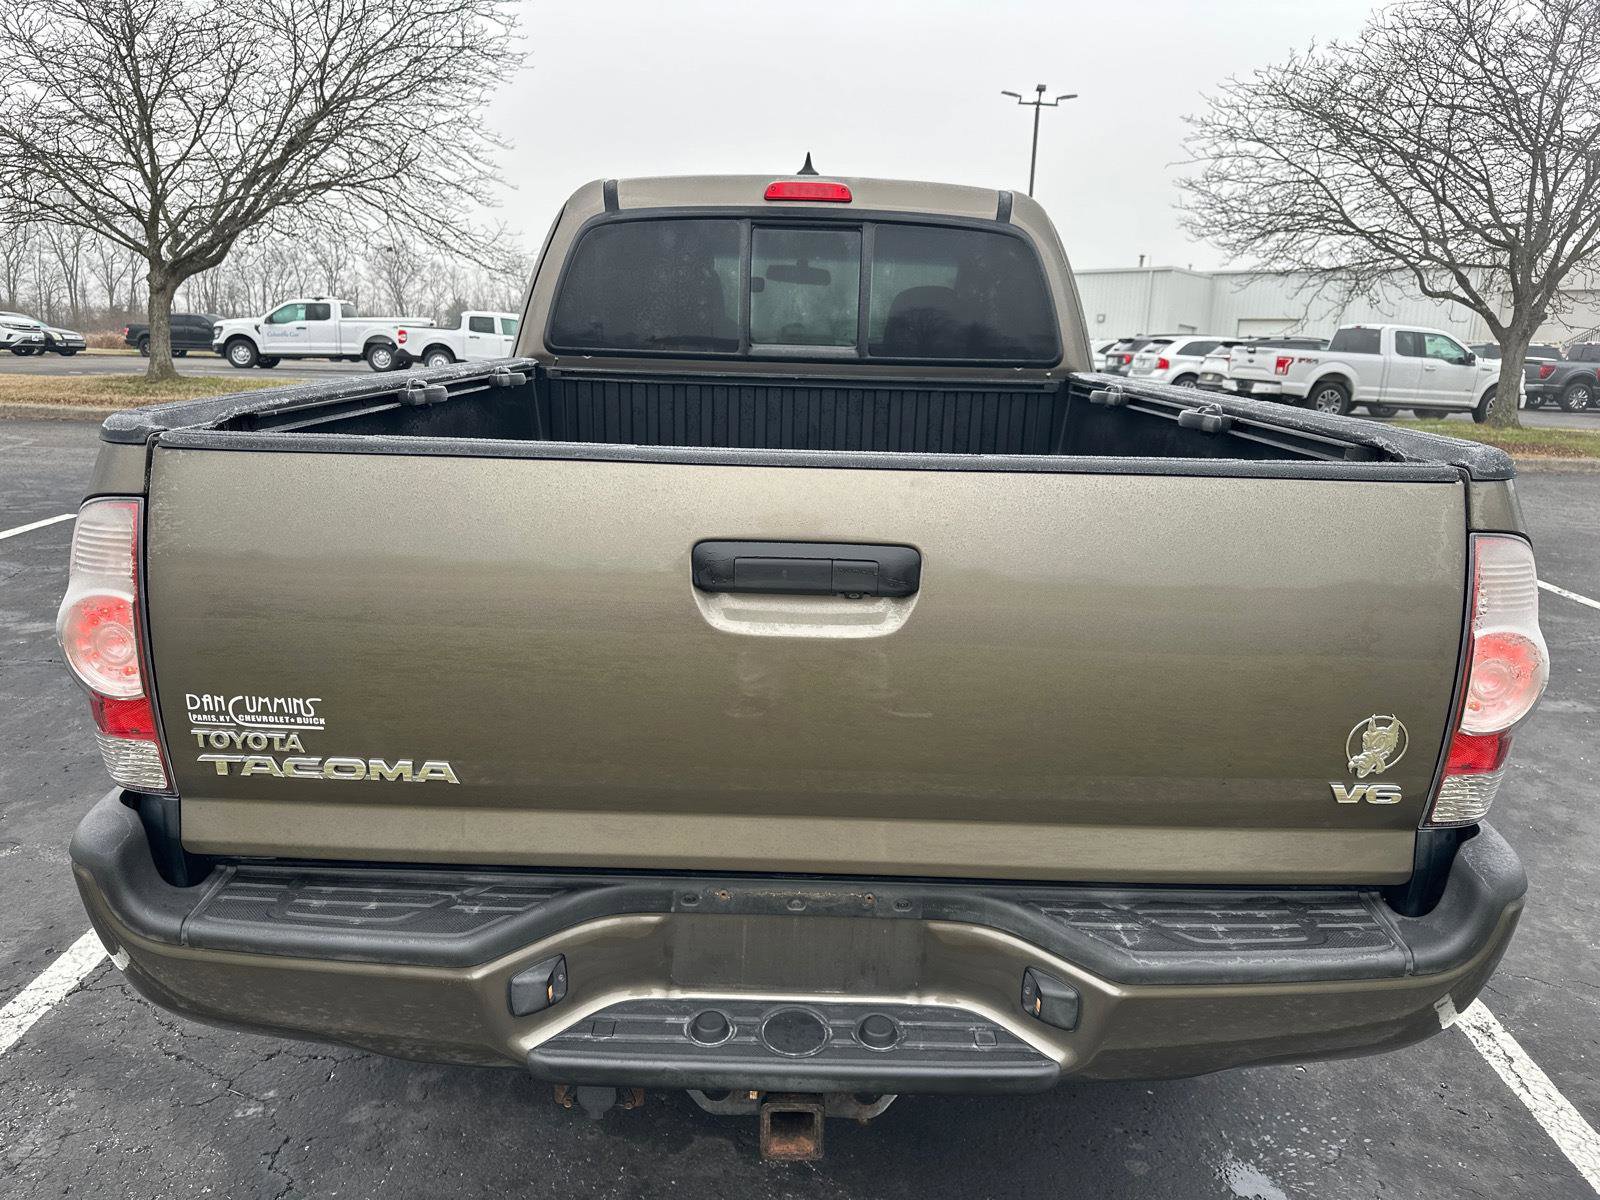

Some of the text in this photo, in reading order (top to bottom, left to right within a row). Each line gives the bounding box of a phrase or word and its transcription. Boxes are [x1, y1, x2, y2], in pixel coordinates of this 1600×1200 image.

[185, 694, 322, 721] DAN CUMMINS
[238, 714, 326, 725] CHEVROLET BUICK
[190, 729, 306, 754] TOYOTA
[197, 754, 461, 785] TACOMA
[1328, 782, 1403, 805] V6
